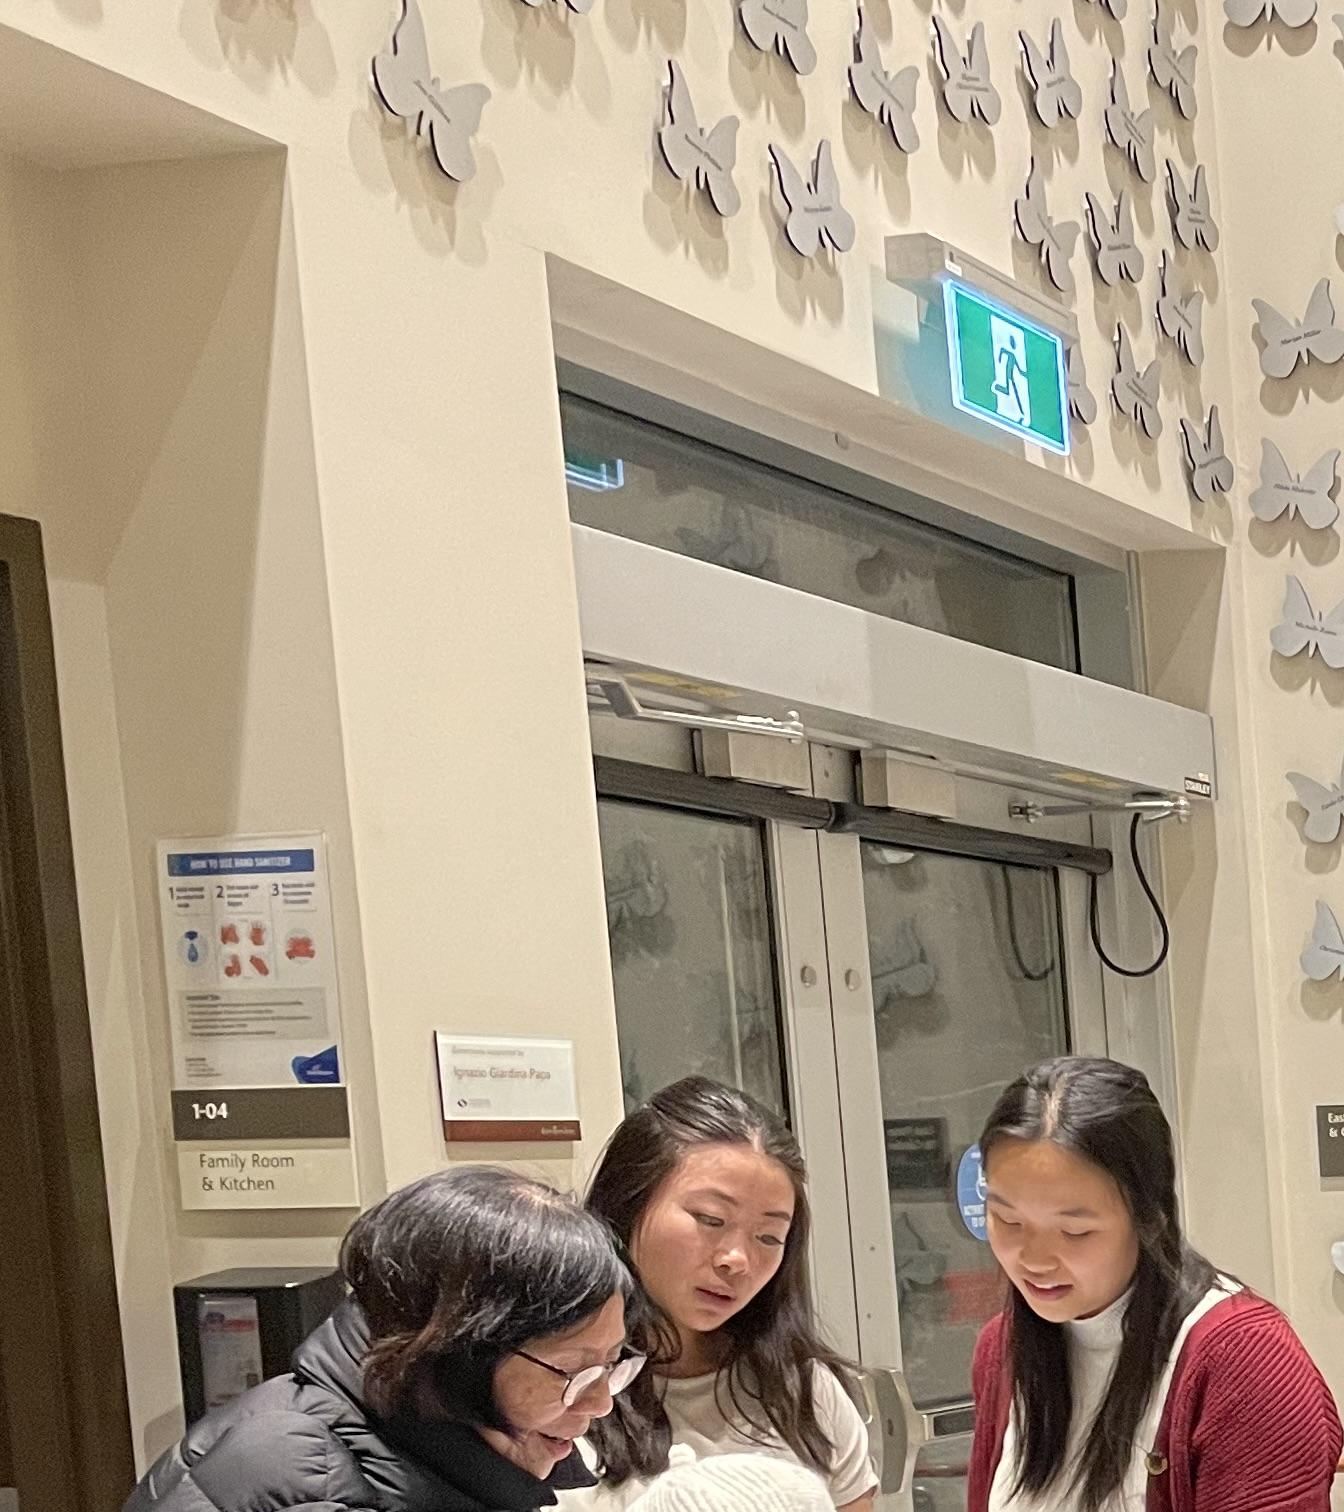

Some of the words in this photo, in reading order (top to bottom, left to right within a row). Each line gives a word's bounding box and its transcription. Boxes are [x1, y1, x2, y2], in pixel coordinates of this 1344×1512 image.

[169, 887, 175, 900] 1
[216, 885, 225, 898] 2
[271, 883, 280, 896] 3
[191, 1102, 228, 1120] 1-04
[1329, 1127, 1338, 1138] &
[199, 1153, 246, 1172] Family
[252, 1153, 295, 1168] Room
[202, 1176, 214, 1191] &
[220, 1176, 275, 1191] Kitchen
